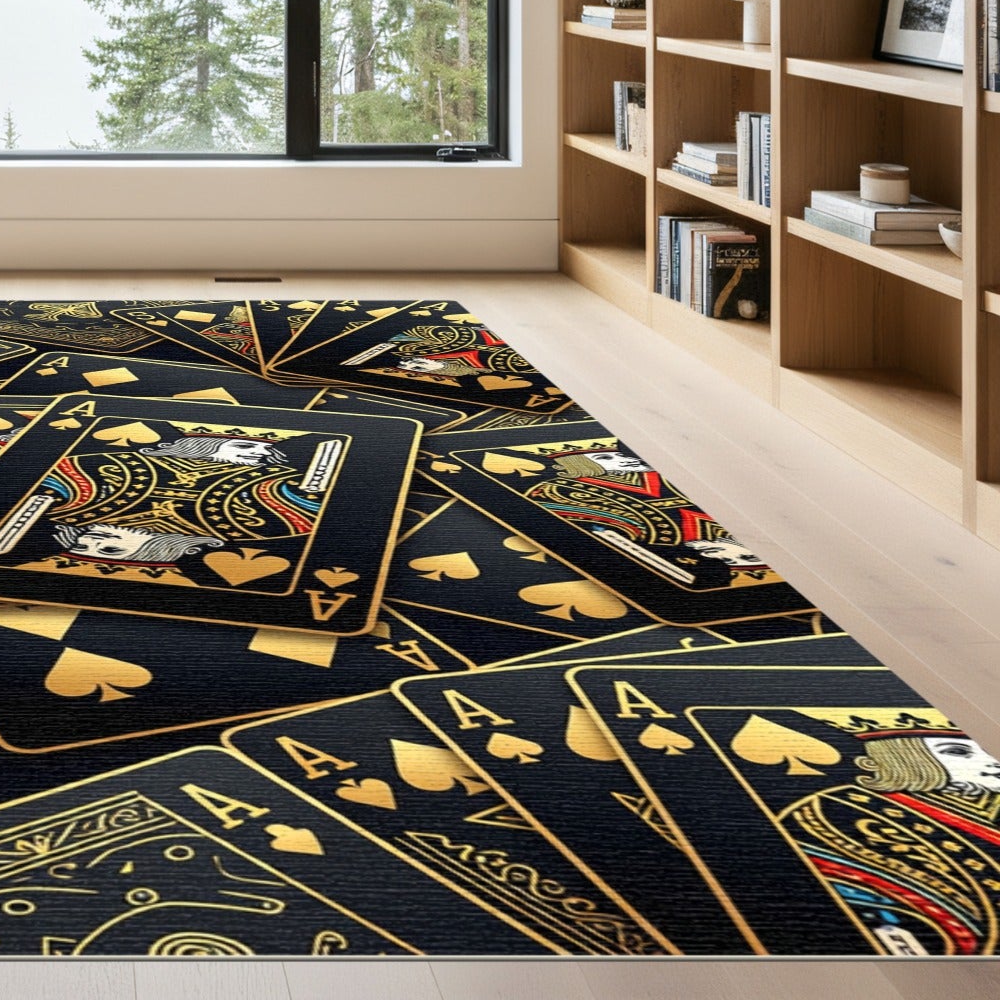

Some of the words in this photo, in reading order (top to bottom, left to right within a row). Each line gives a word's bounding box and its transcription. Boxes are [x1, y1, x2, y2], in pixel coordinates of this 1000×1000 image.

[420, 302, 448, 311] A
[41, 356, 70, 367] A
[58, 401, 97, 417] A
[524, 394, 560, 407] A
[304, 590, 357, 621] A
[374, 640, 440, 671] A
[442, 689, 514, 729] A
[613, 681, 675, 718] A
[275, 736, 358, 780] A
[180, 784, 269, 829] A
